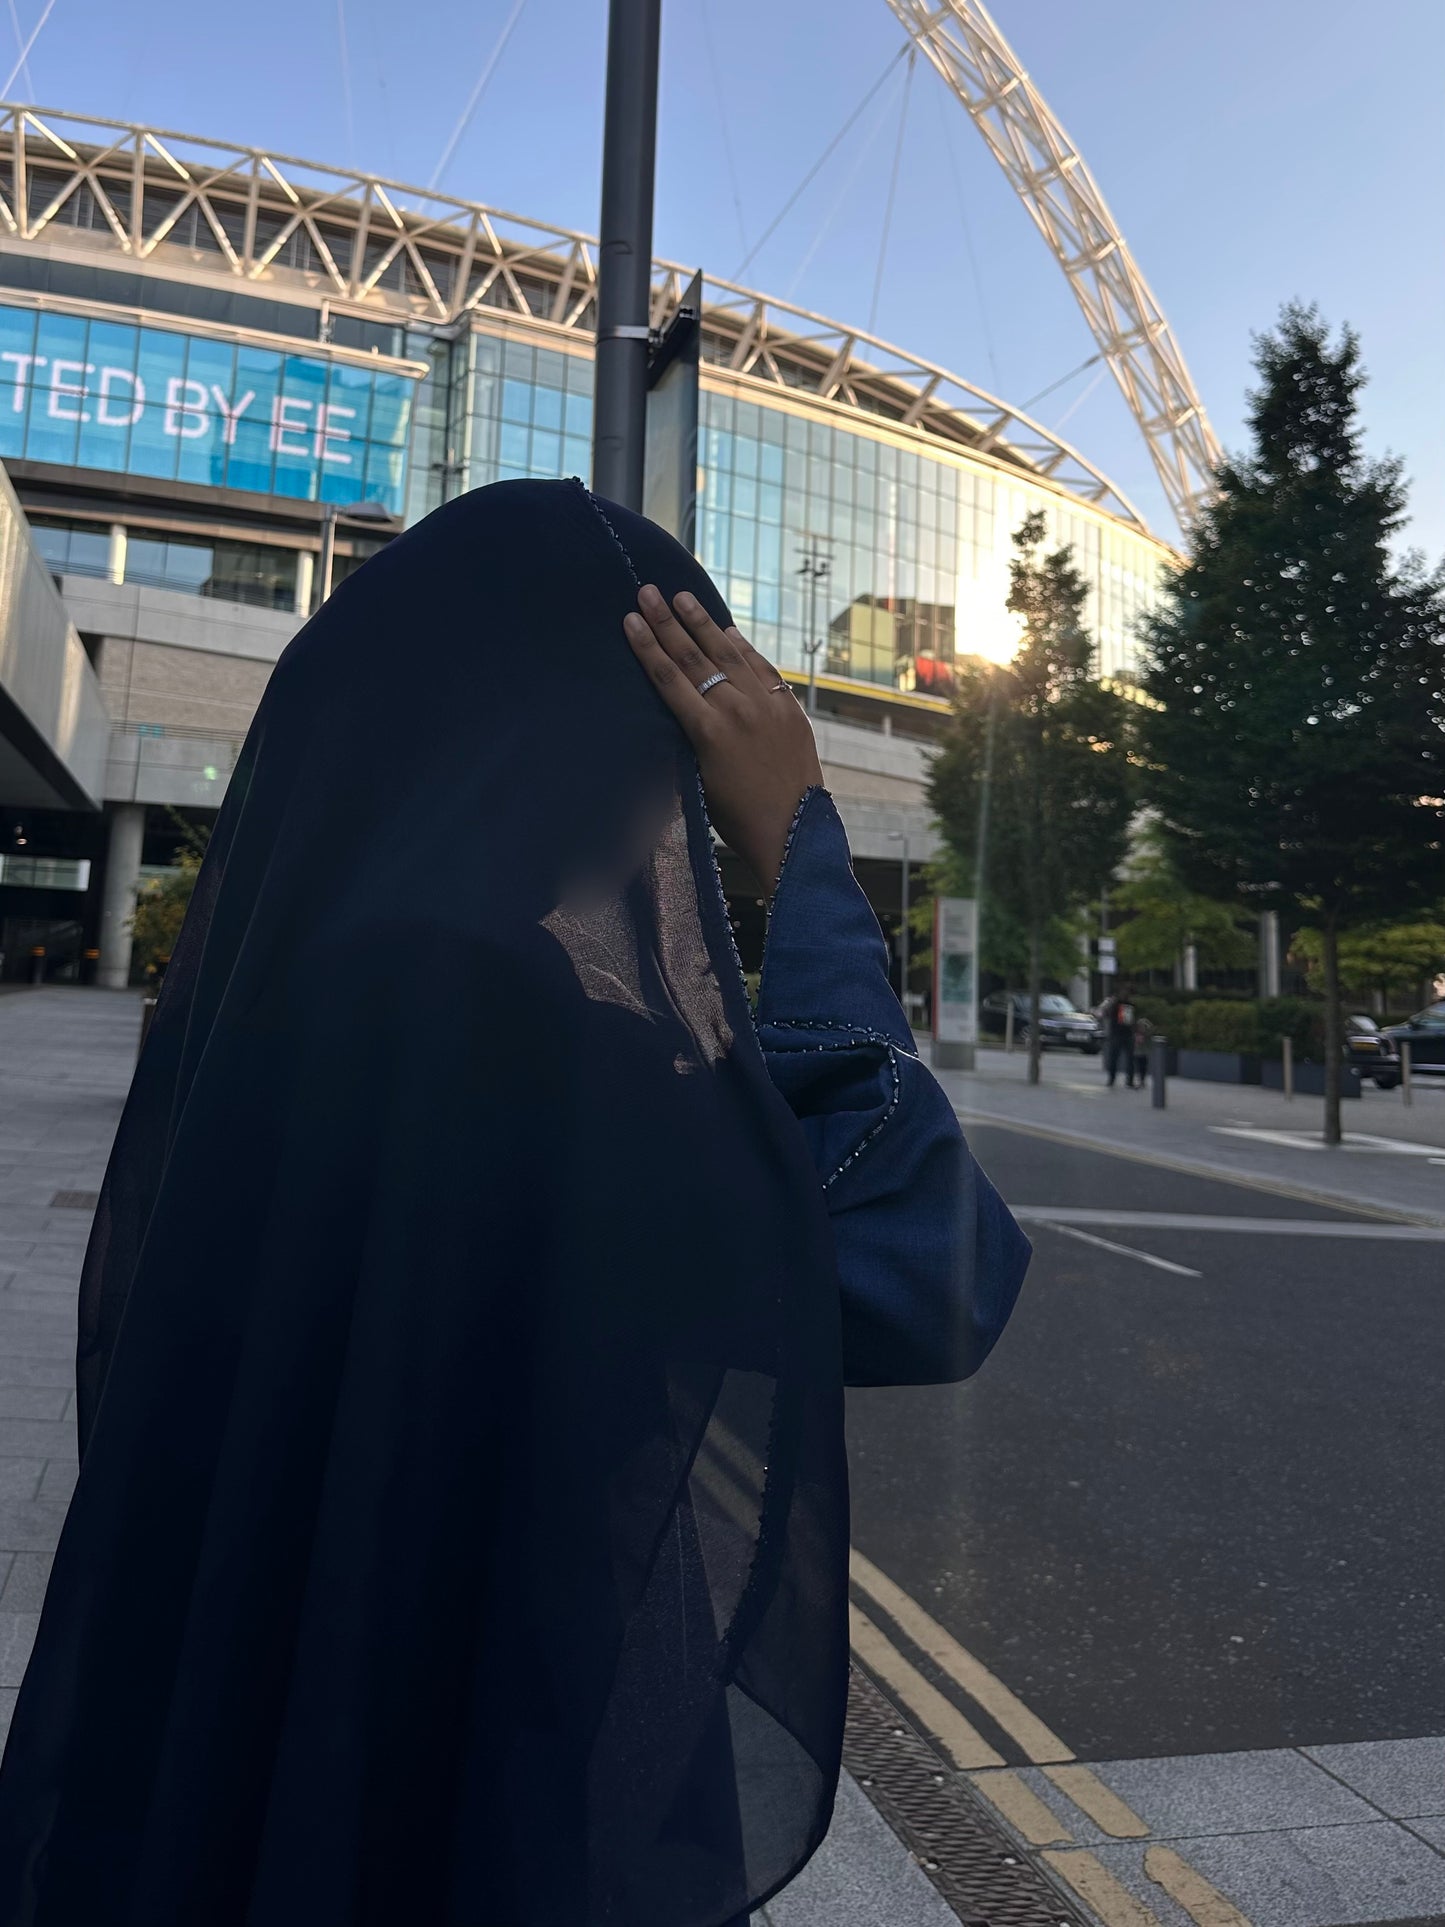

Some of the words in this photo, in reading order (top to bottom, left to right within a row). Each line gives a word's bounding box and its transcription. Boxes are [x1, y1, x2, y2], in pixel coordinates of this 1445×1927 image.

[2, 352, 146, 426] TED
[163, 377, 256, 445] BY
[269, 395, 357, 464] EE
